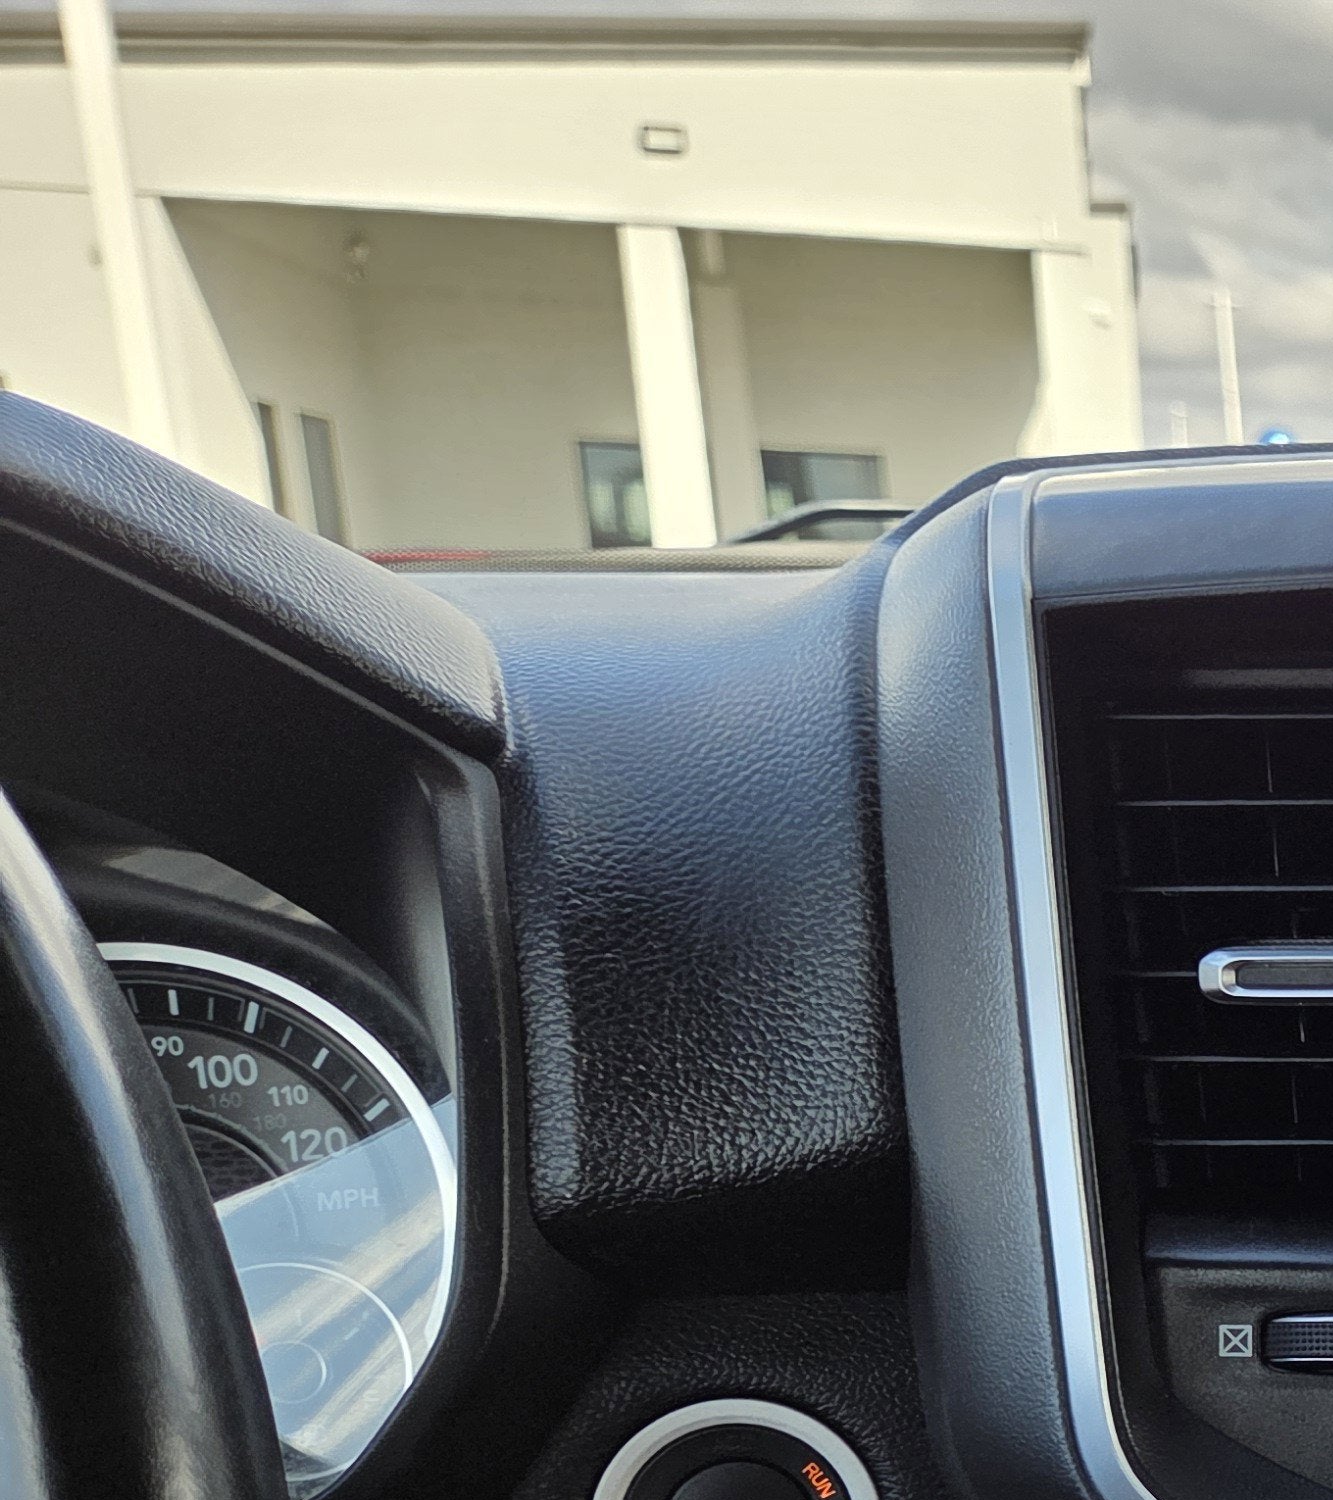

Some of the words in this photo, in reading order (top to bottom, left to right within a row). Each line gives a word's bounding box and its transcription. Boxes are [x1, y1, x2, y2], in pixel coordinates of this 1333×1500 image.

[151, 1036, 184, 1057] 90
[187, 1053, 258, 1089] 100
[267, 1084, 310, 1107] 110
[280, 1126, 348, 1163] 120
[317, 1187, 379, 1212] MPH
[801, 1462, 837, 1499] RUN
